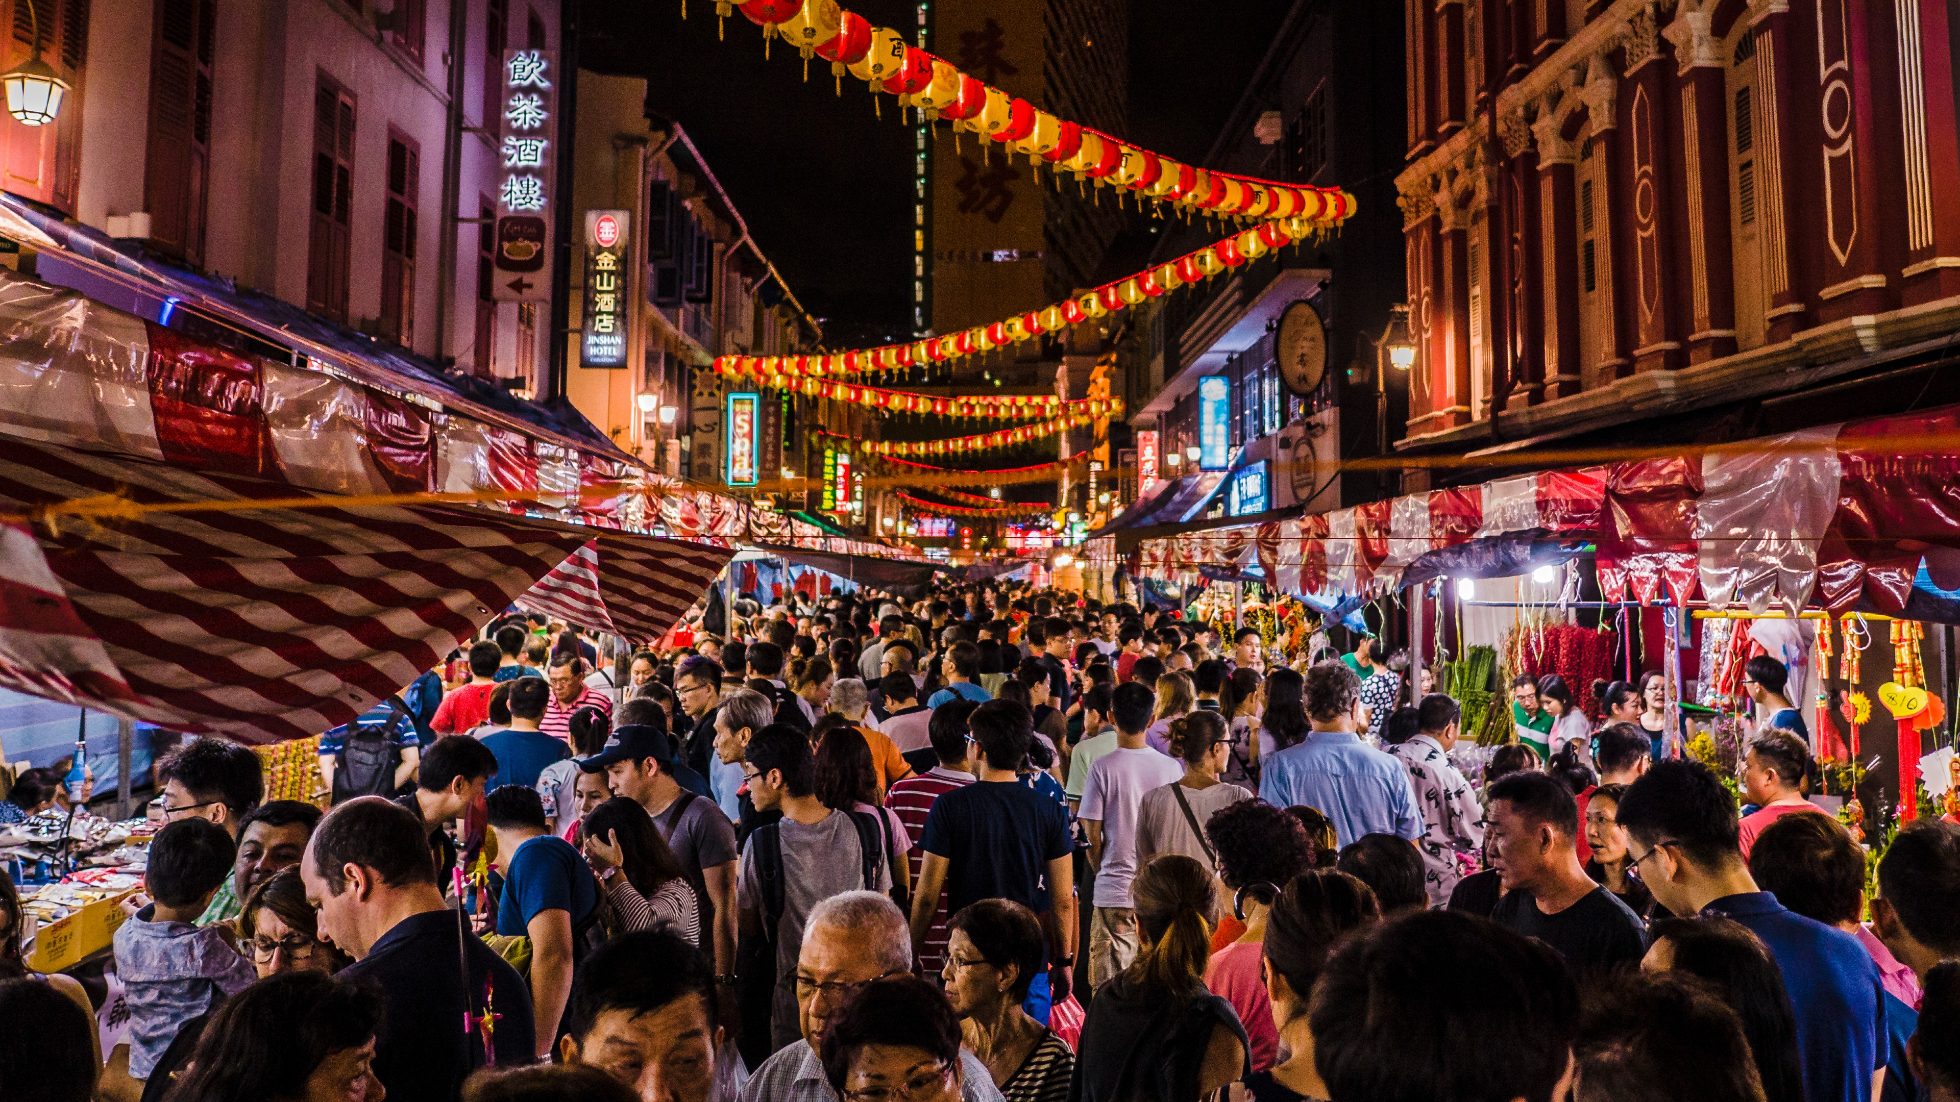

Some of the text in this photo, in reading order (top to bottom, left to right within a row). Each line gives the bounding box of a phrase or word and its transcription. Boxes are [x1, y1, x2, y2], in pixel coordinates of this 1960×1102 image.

[503, 53, 548, 209] 飲茶酒樓
[595, 251, 616, 332] 金山酒店
[587, 335, 622, 345] JINSHAN
[590, 346, 618, 356] HOTEL
[1886, 693, 1918, 711] $10
